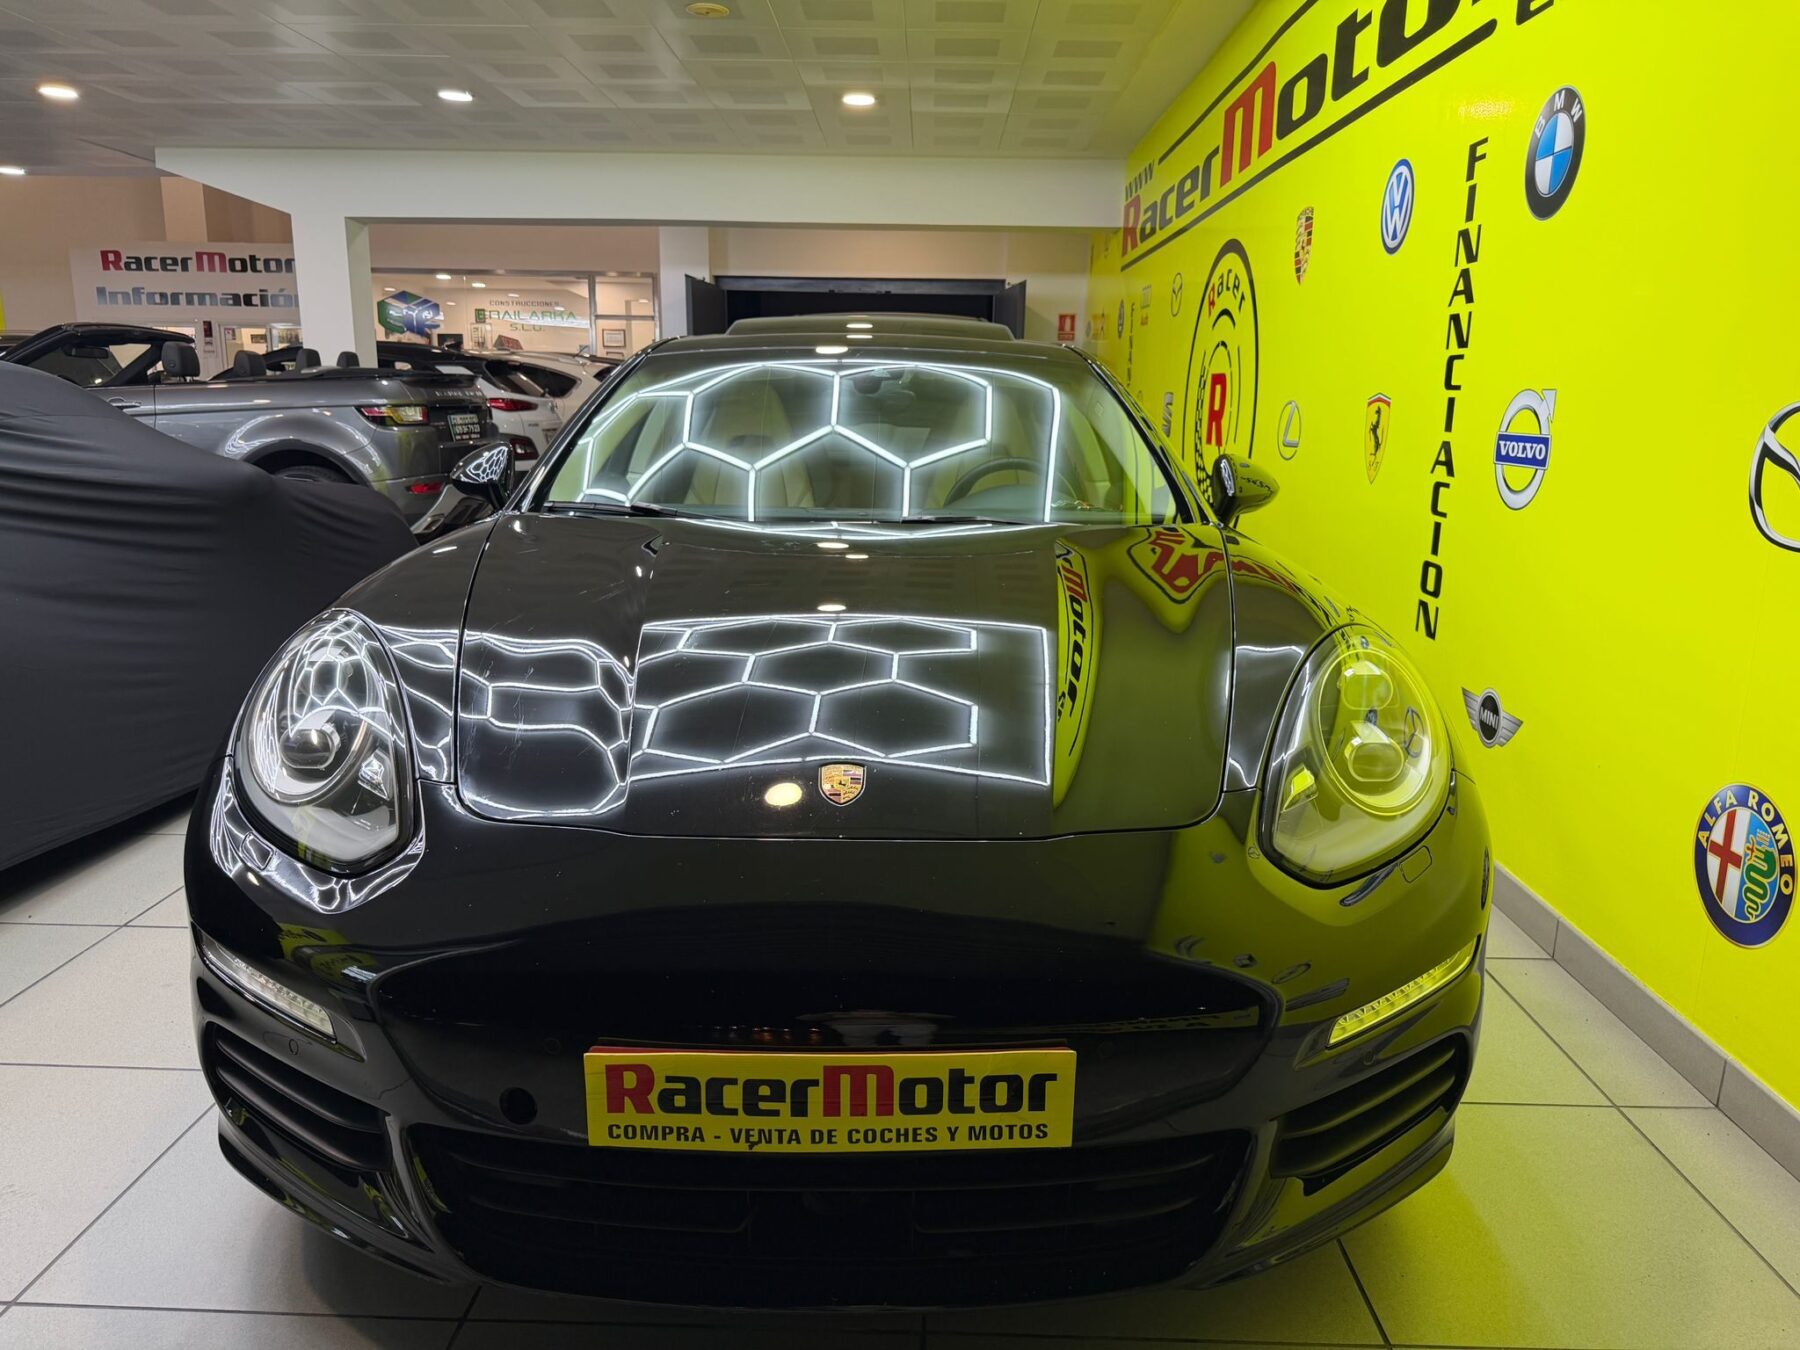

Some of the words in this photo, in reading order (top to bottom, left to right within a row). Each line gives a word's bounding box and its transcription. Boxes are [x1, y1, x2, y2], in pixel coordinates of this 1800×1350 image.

[1121, 0, 1483, 258] RacerMoto
[1534, 89, 1583, 139] BMW
[100, 250, 295, 274] RacerMotor
[1208, 268, 1246, 319] Racer
[1206, 373, 1227, 447] R
[1415, 136, 1489, 641] FINANCIACION
[1499, 440, 1546, 460] VOLVO
[1480, 706, 1499, 730] MINI
[1698, 790, 1739, 849] ALFA
[1748, 789, 1794, 897] ROMEO
[605, 1063, 1057, 1118] RacerMotor
[608, 1123, 706, 1143] COMPRA
[730, 1126, 801, 1150] VENTA
[811, 1127, 838, 1145] DE
[848, 1125, 942, 1145] COCHES
[948, 1124, 959, 1142] Y
[967, 1123, 1049, 1141] MOTOS
